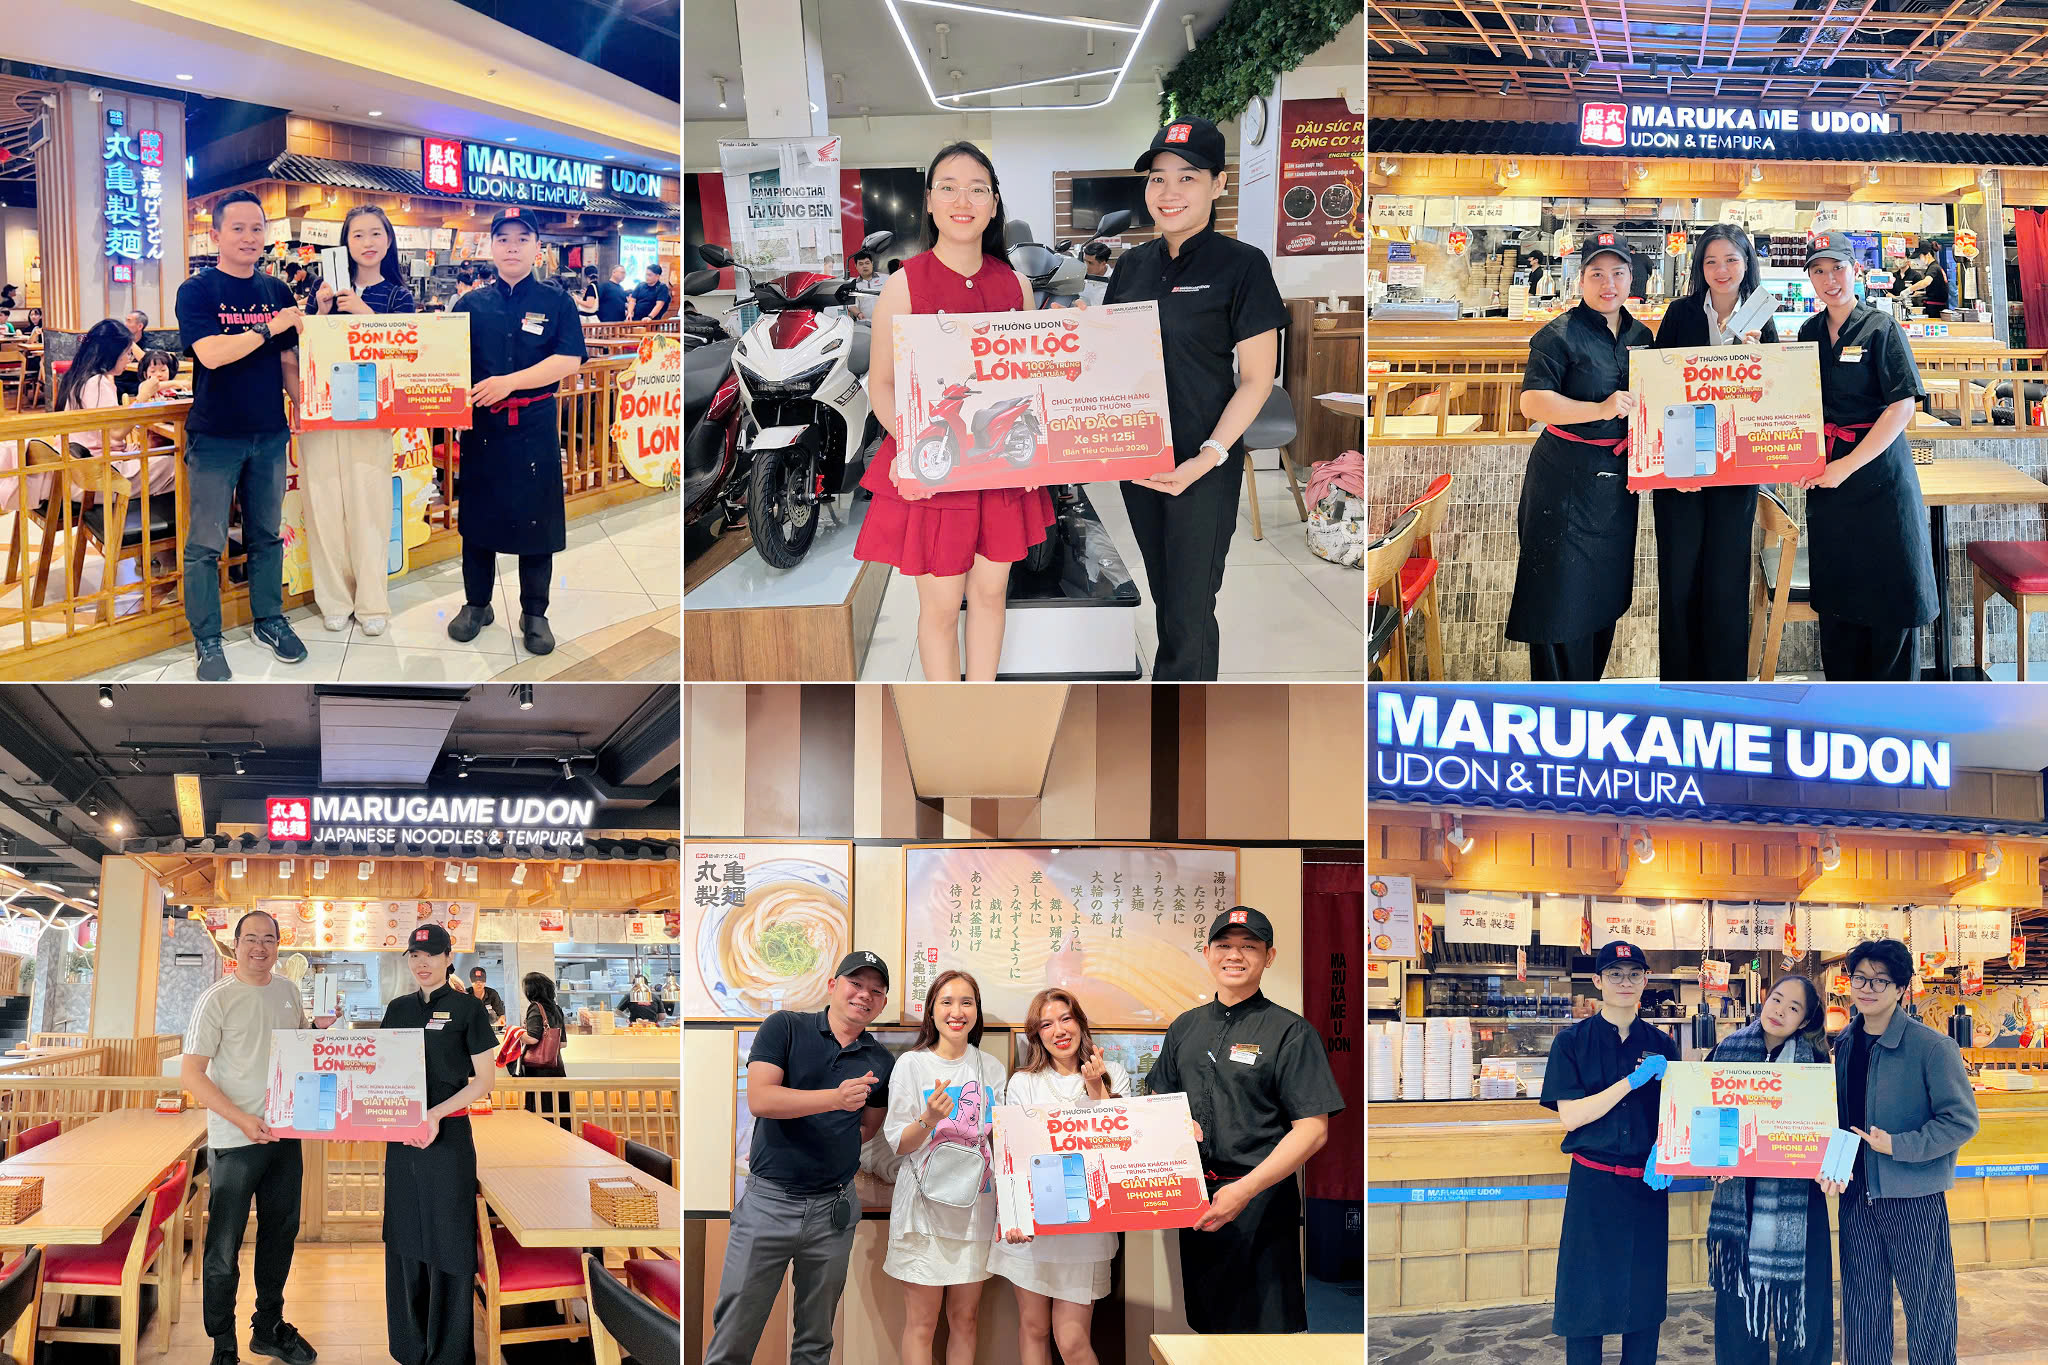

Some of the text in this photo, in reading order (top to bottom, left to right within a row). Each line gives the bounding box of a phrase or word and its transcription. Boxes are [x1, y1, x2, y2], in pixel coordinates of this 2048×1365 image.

[1296, 119, 1352, 134] DẦU SÚC
[1583, 108, 1605, 141] 製麺
[1605, 108, 1624, 141] 丸亀
[1631, 105, 1890, 134] MARUKAME UDON
[141, 132, 162, 164] 讃岐
[1291, 135, 1328, 150] ĐỘNG
[1330, 135, 1351, 147] CƠ
[1631, 132, 1776, 150] UDON & TEMPURA
[443, 147, 458, 188] 丸亀
[468, 144, 661, 198] MARUKAME UDON
[103, 132, 143, 260] 丸亀製麺
[468, 176, 590, 206] UDON & TEMPURA
[774, 187, 805, 197] PHONG
[141, 167, 164, 259] 釜揚げうどん
[1034, 320, 1061, 329] UDON
[347, 329, 418, 346] ĐÓN LỘC
[971, 331, 1080, 358] ĐÓN LỘC
[349, 345, 384, 361] LỚN
[974, 358, 1029, 382] LỚN
[1025, 361, 1055, 371] 100%
[1683, 363, 1762, 383] ĐÓN LỘC
[408, 396, 437, 404] IPHONE
[1051, 398, 1073, 406] CHÚC
[1100, 393, 1126, 402] KHÁCH
[1685, 383, 1724, 402] LỚN
[620, 390, 661, 420] ĐÓN
[1071, 404, 1097, 412] TRÚNG
[1050, 410, 1157, 431] GIẢI ĐẶC BIỆT
[1074, 431, 1135, 445] Xe SH 125i
[1748, 427, 1805, 441] GIẢI NHẤT
[1126, 444, 1148, 452] 2026)
[1752, 443, 1802, 453] IPHONE AIR
[402, 448, 429, 471] AIR
[1376, 690, 1953, 790] MARUKAME UDON
[1376, 751, 1706, 807] UDON & TEMPURA
[271, 802, 306, 819] 丸亀
[313, 796, 594, 826] MARUGAME UDON
[271, 819, 306, 837] 製麺
[314, 828, 585, 846] JAPANESE NOODLES & TEMPURA
[694, 860, 746, 885] 丸亀
[694, 885, 746, 907] 製麺
[1029, 870, 1042, 925] 差し水に
[1090, 870, 1104, 925] 大輪の花
[1131, 884, 1145, 911] 生麺
[1152, 871, 1164, 925] うちたて
[1213, 871, 1226, 917] 湯けむ
[969, 870, 982, 952] あとは釜揚げ
[1111, 871, 1124, 938] とうずれば
[1172, 884, 1186, 924] 大釜に
[949, 883, 962, 952] 待つばかり
[989, 897, 1002, 939] 戯れば
[1049, 898, 1062, 953] 舞い踊る
[1070, 885, 1083, 952] 咲くように
[1193, 885, 1206, 953] たちのぼる
[1462, 917, 1516, 930] 丸亀製麺
[1009, 884, 1022, 979] うなずくように
[1608, 924, 1657, 937] 丸亀製麺
[1728, 925, 1775, 936] 丸亀製麺
[1331, 953, 1347, 969] MA
[912, 949, 927, 1001] 丸亀製麺
[1332, 970, 1346, 985] RU
[1331, 987, 1346, 1003] KA
[1330, 1004, 1346, 1019] ME
[1333, 1020, 1342, 1036] U
[312, 1042, 376, 1059] ĐÓN LỘC
[1328, 1037, 1350, 1053] DON
[313, 1057, 345, 1071] LỚN
[1710, 1076, 1782, 1093] ĐÓN LỘC
[1712, 1091, 1749, 1106] LỚN
[365, 1108, 393, 1116] IPHONE
[1047, 1115, 1129, 1134] ĐÓN LỘC
[1050, 1133, 1111, 1152] LỚN 100%
[1121, 1173, 1183, 1189] GIẢI NHẤT
[1126, 1189, 1182, 1200] IPHONE AIR
[1427, 1188, 1501, 1197] MARUKAME UDON
